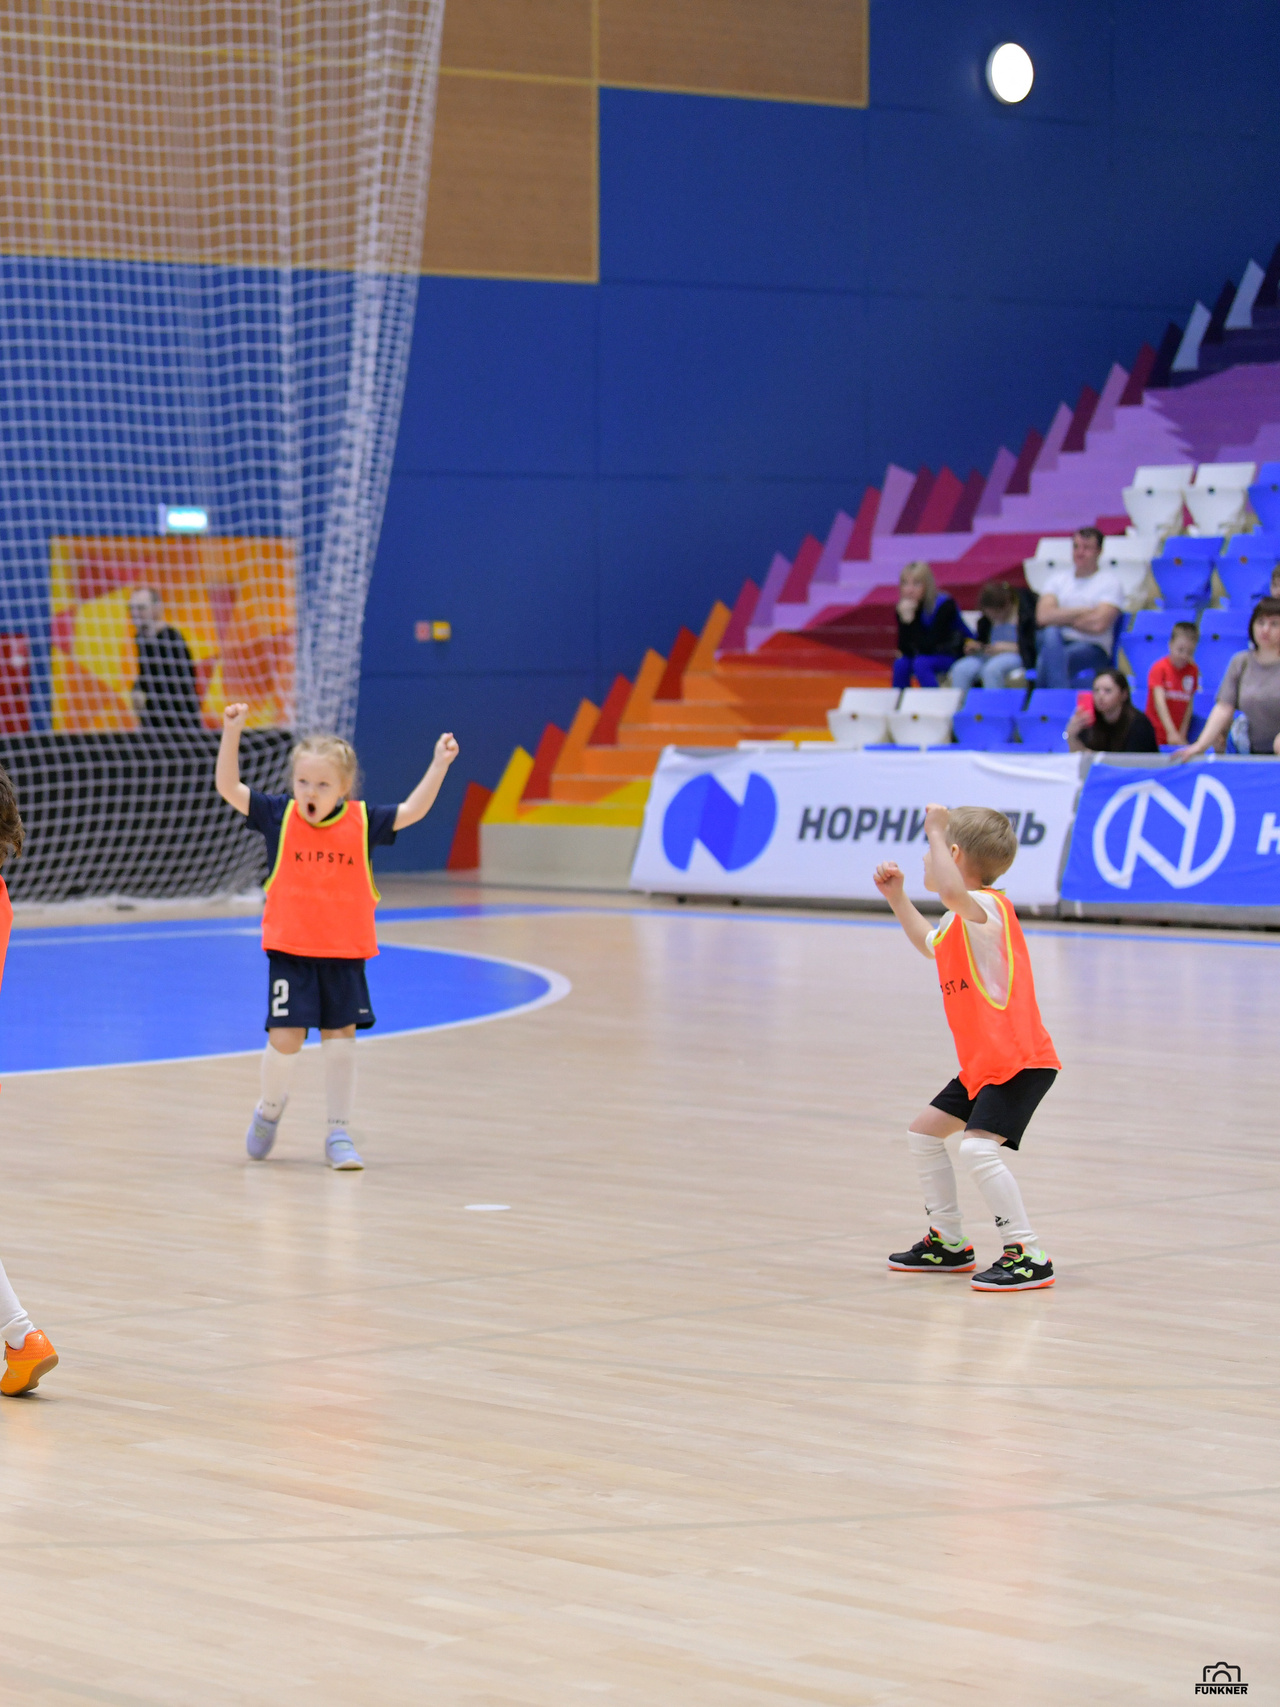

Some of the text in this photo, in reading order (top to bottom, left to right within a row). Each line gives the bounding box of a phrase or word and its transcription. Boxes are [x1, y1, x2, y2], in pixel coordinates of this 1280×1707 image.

[294, 851, 354, 866] KIPSTA
[940, 978, 970, 996] STA
[272, 978, 290, 1017] 2
